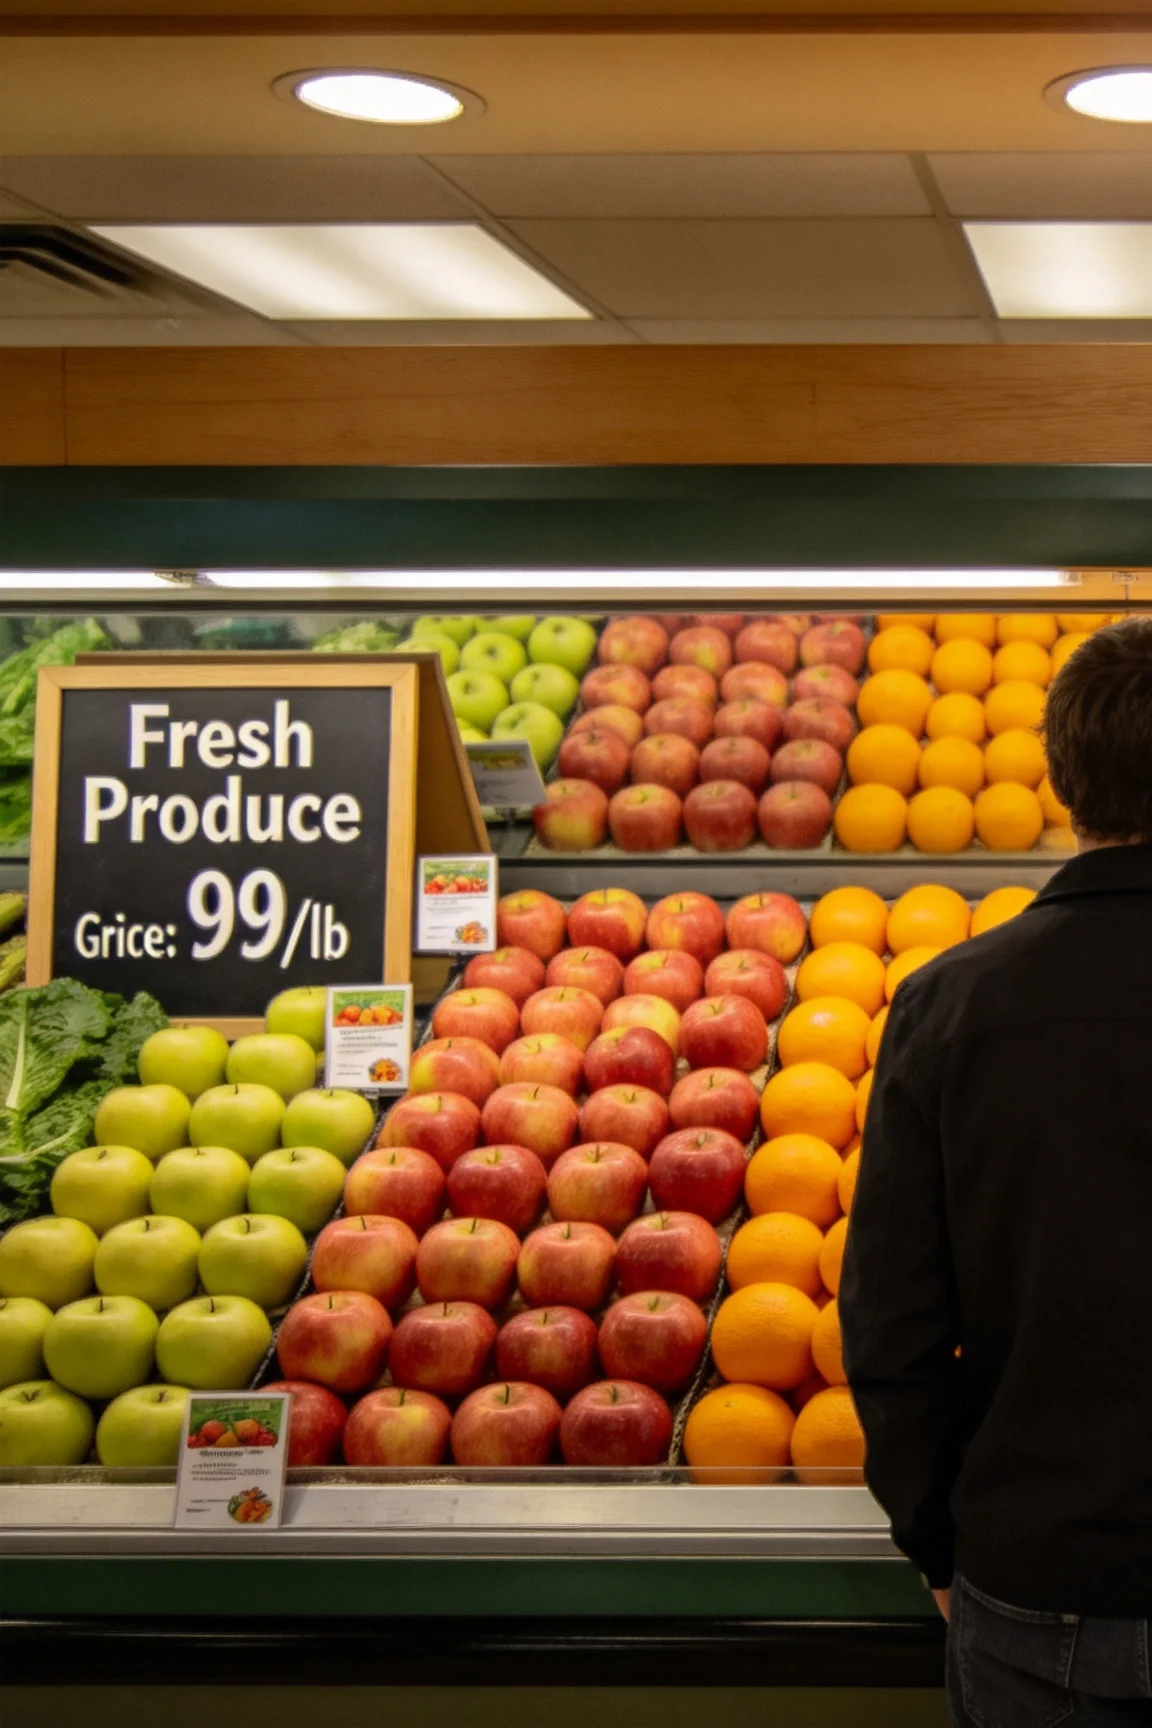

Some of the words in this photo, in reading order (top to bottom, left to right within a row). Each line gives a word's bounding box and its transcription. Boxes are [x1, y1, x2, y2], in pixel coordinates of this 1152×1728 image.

[128, 700, 313, 769] Fresh
[83, 775, 362, 844] Produce
[74, 912, 176, 961] Grice:
[187, 869, 349, 969] 99/lb
